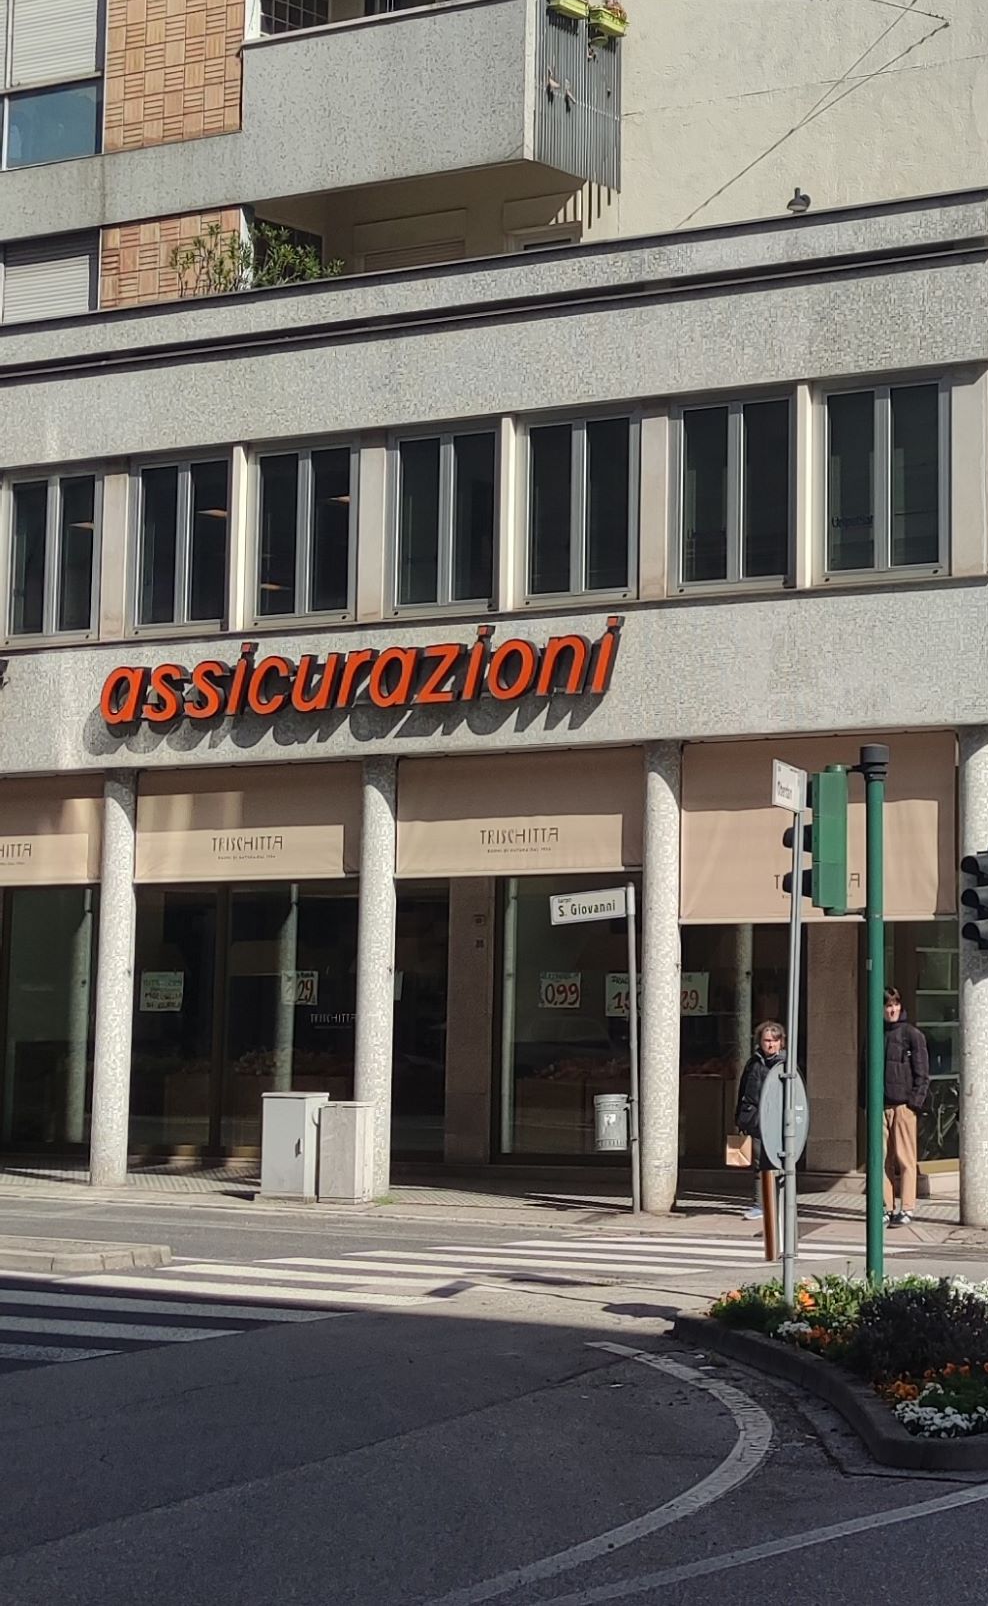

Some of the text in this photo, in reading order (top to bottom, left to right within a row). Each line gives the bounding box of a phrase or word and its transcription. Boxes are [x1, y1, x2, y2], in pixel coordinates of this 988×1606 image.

[100, 615, 625, 725] assicurazioni
[212, 835, 283, 852] TRISCHITTA
[480, 827, 559, 845] TRISCHITTA
[570, 899, 616, 916] Giovanni
[545, 983, 580, 1006] 0,99
